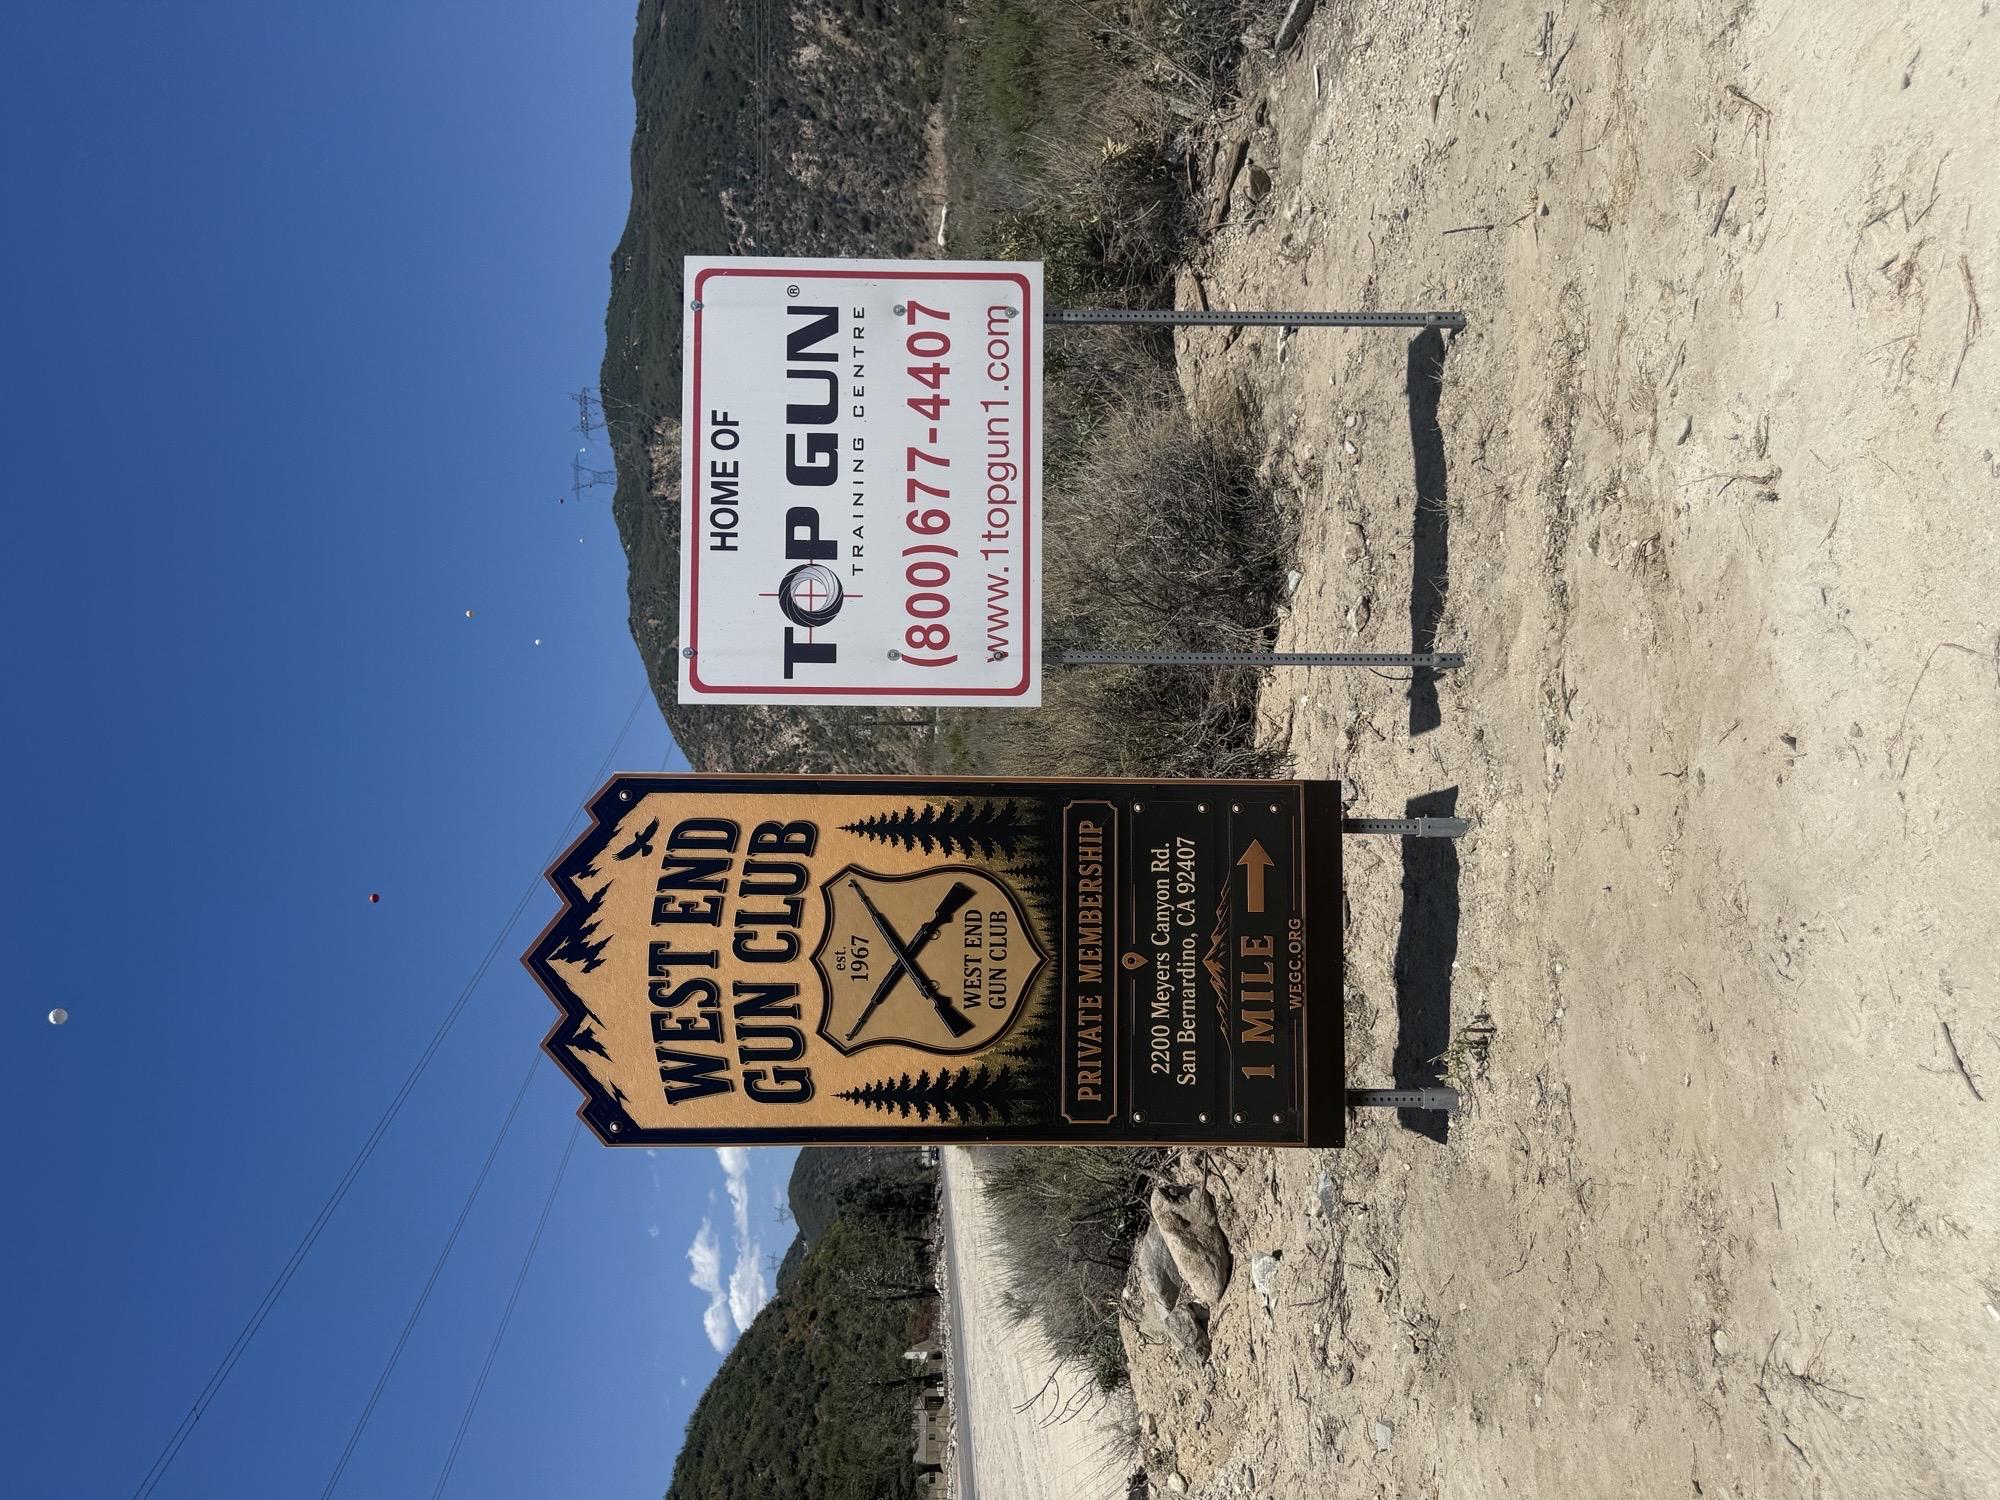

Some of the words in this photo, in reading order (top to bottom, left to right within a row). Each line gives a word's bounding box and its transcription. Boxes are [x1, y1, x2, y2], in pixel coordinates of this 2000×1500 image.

[852, 306, 865, 417] CENTRE
[711, 410, 740, 450] OF
[710, 460, 739, 552] HOME
[852, 438, 865, 575] TRAINING
[901, 300, 958, 668] (800)677-4407
[980, 305, 1016, 663] www.1topgun1.com
[778, 506, 844, 680] TOP
[651, 817, 740, 927] END
[732, 820, 817, 963] CLUB
[1152, 843, 1170, 873] Rd.
[1177, 837, 1196, 893] 92407
[964, 909, 982, 948] END
[989, 911, 1008, 962] CLUB
[1079, 820, 1102, 983] MEMBERSHIP
[1152, 879, 1174, 946] Canyon
[1178, 899, 1196, 926] CA
[834, 947, 846, 971] est.
[851, 935, 869, 982] 1967
[963, 953, 982, 1009] WEST
[989, 965, 1008, 1010] GUN
[1152, 952, 1174, 1018] Meyers
[1177, 933, 1198, 1043] Bernardino,
[1241, 935, 1274, 1044] MILE
[1288, 918, 1302, 1009] WEGC.ORG
[648, 941, 734, 1105] WEST
[732, 981, 814, 1104] GUN
[1078, 995, 1102, 1101] PRIVATE
[1152, 1025, 1170, 1074] 2200
[1177, 1050, 1196, 1085] San
[1242, 1065, 1275, 1079] 1
